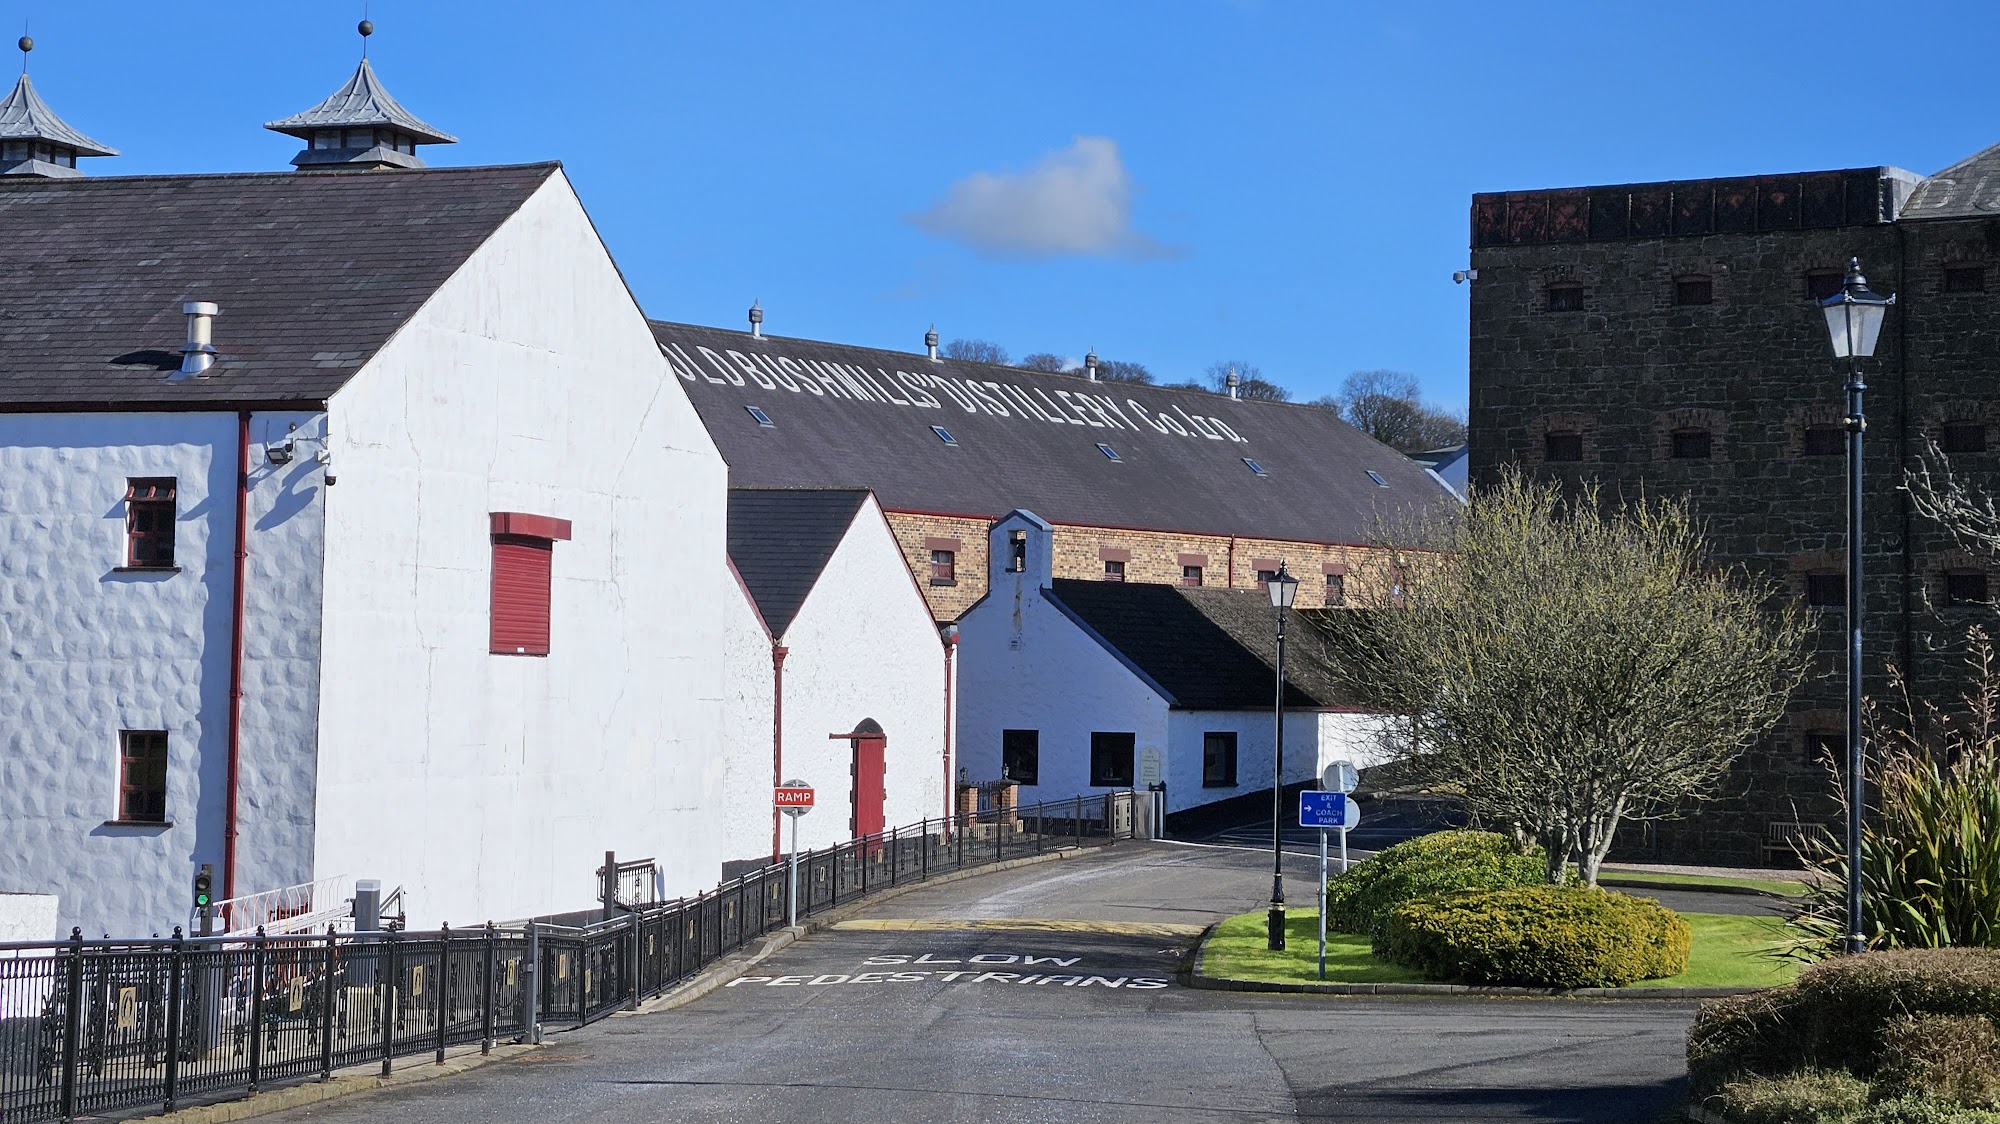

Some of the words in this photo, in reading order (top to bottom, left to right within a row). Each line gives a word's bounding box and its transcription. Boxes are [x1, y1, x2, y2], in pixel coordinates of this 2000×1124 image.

[660, 342, 746, 387] OLD
[929, 374, 1140, 431] DISTILLERY
[777, 792, 811, 802] RAMP
[1315, 809, 1343, 817] COACH
[863, 953, 1082, 967] SLOW
[725, 970, 1169, 989] PEDESTRIANS
